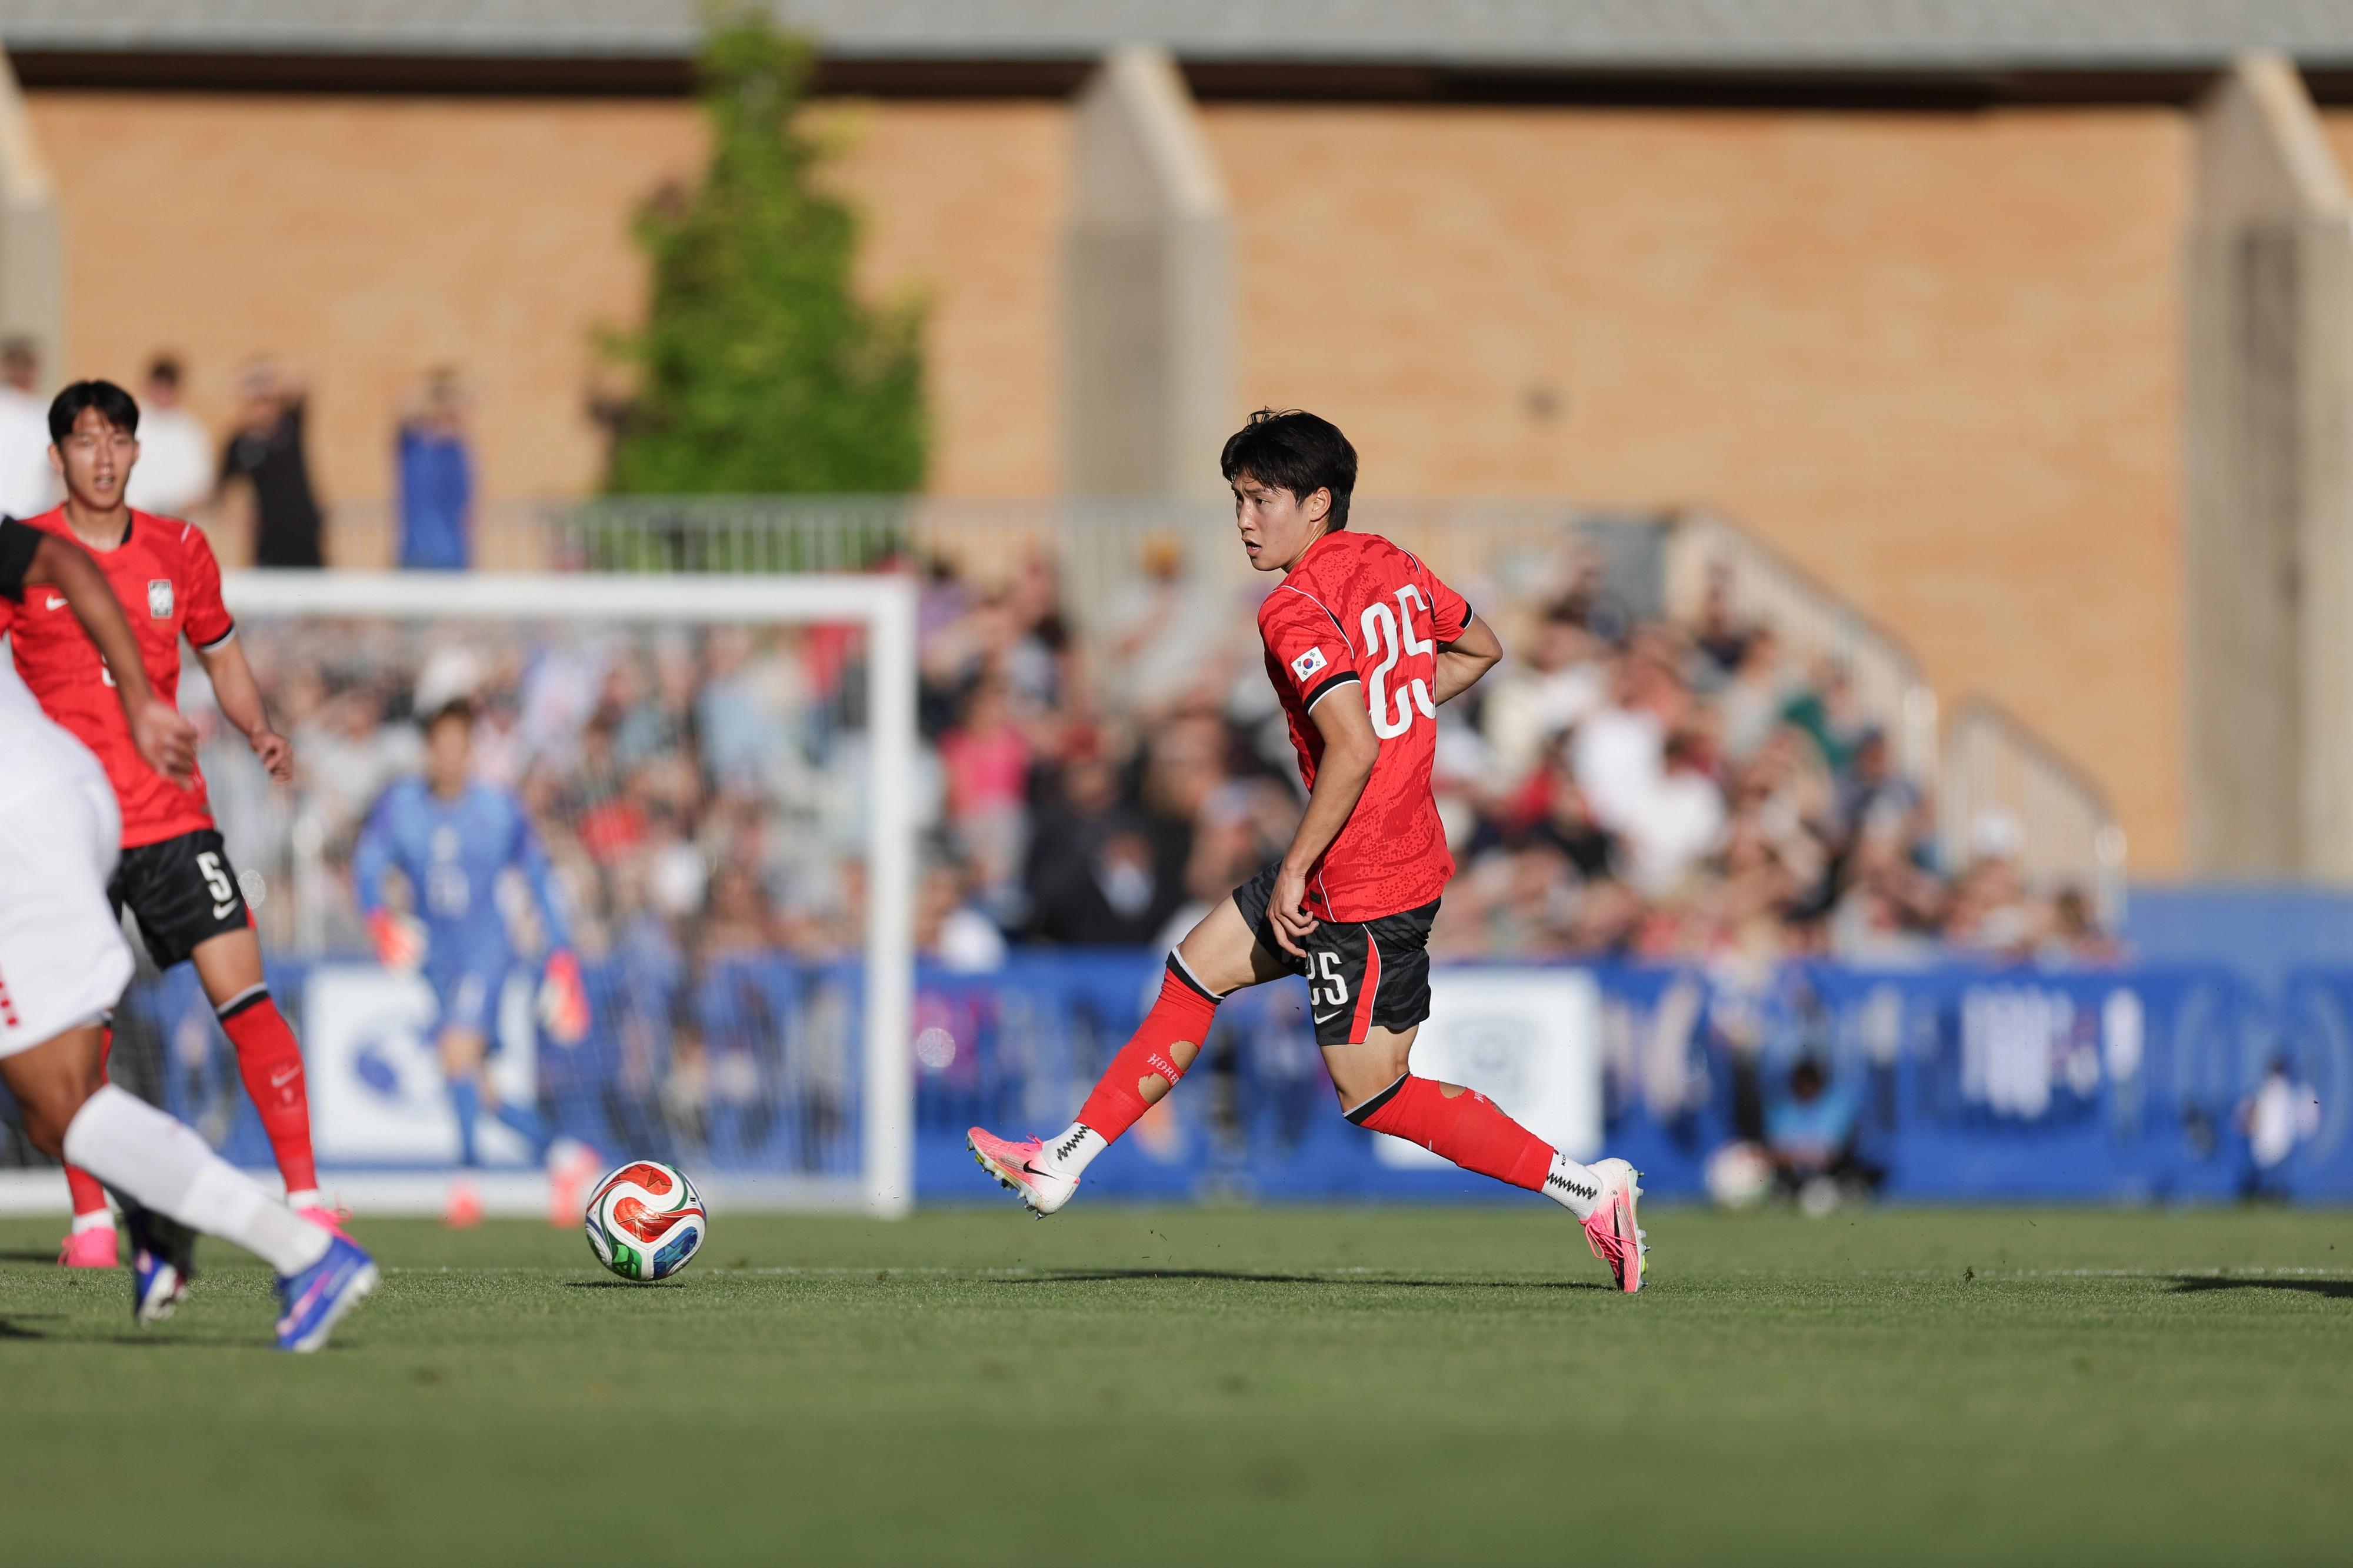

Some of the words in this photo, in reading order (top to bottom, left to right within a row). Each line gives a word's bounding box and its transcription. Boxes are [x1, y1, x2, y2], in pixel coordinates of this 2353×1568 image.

[1361, 583, 1436, 739] 25
[195, 850, 232, 903] 5
[1305, 952, 1348, 1006] 25
